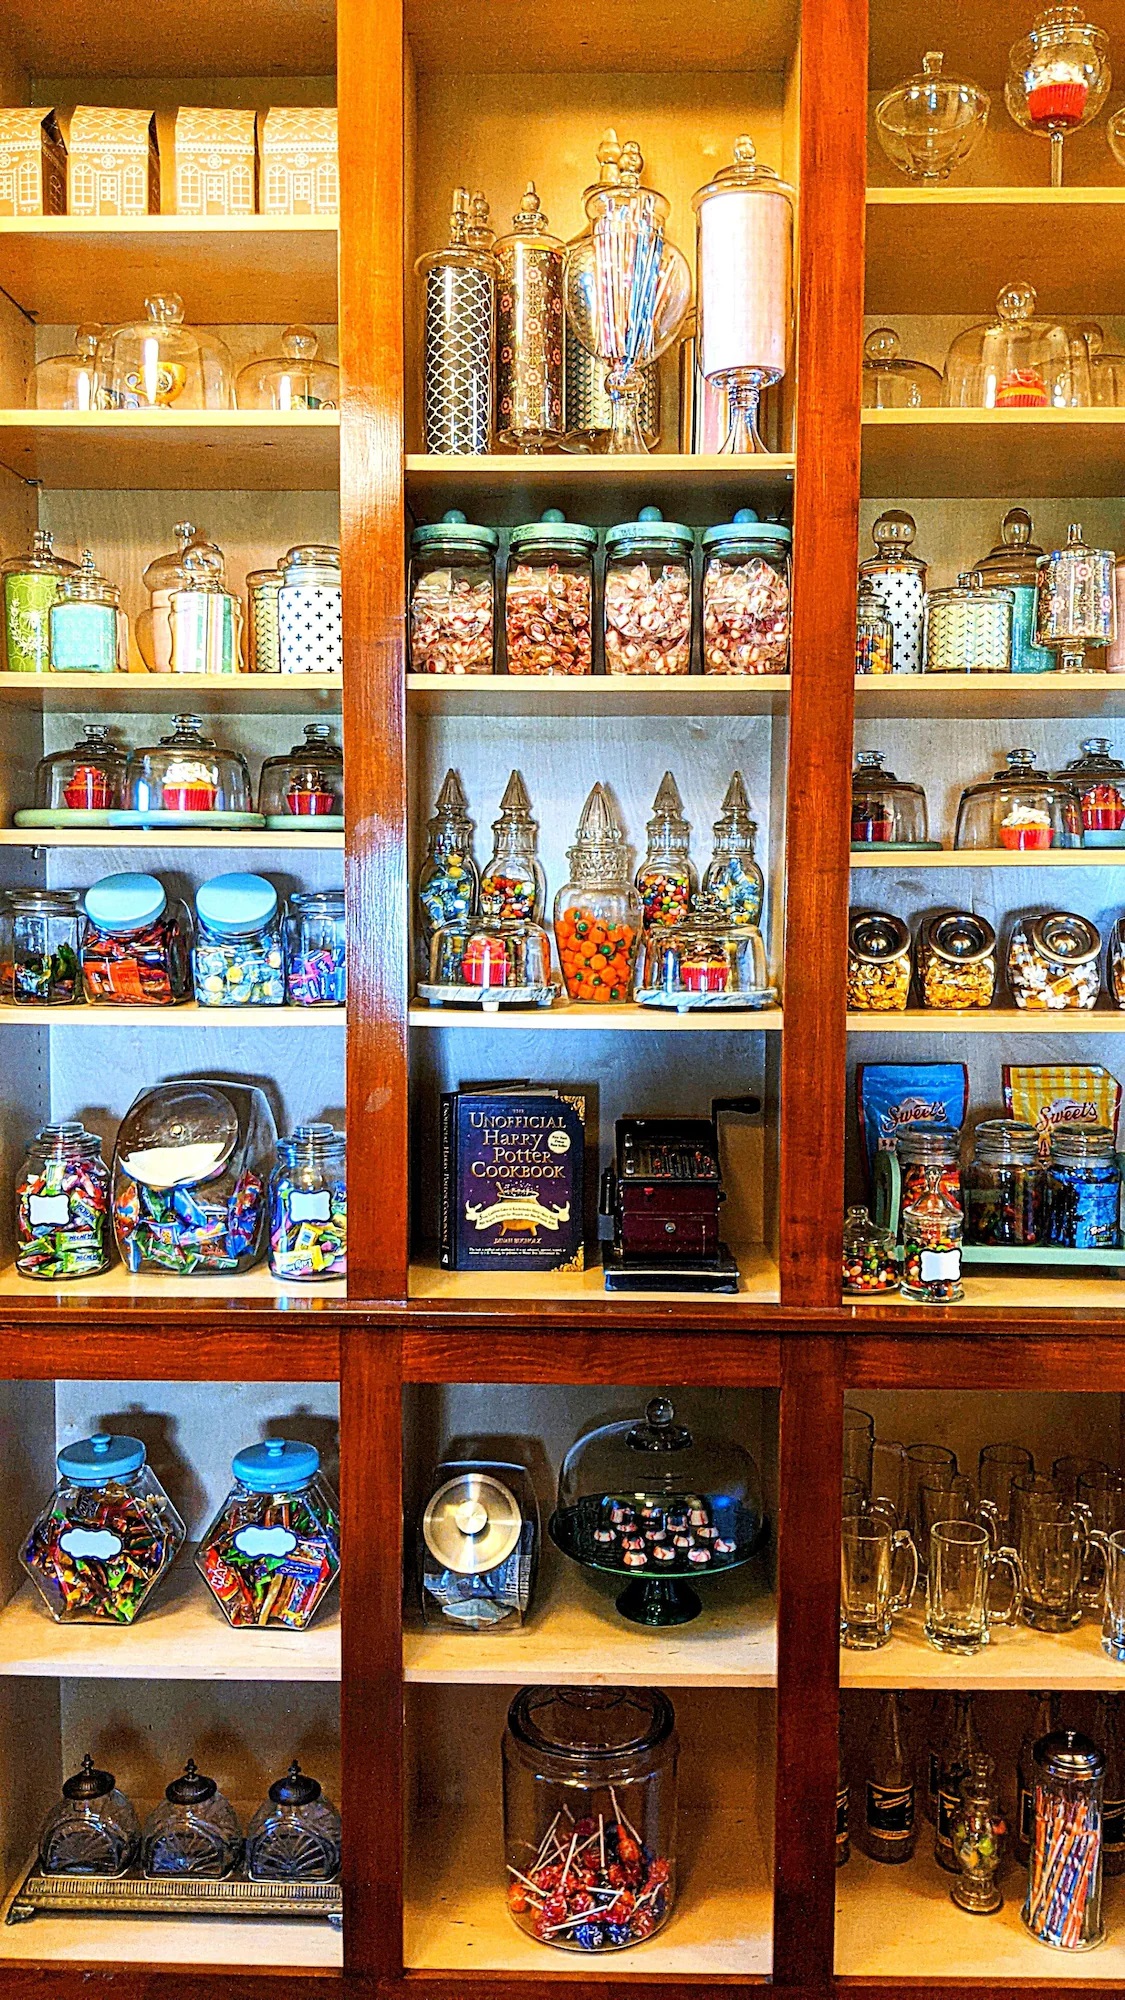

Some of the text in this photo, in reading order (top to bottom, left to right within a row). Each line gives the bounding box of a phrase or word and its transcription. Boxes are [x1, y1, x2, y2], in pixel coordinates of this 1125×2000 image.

[469, 1112, 566, 1128] UNOFFICIAL
[882, 1101, 947, 1132] Sweet's
[1035, 1101, 1098, 1132] Sweet's
[471, 1162, 565, 1178] COOKBOOK
